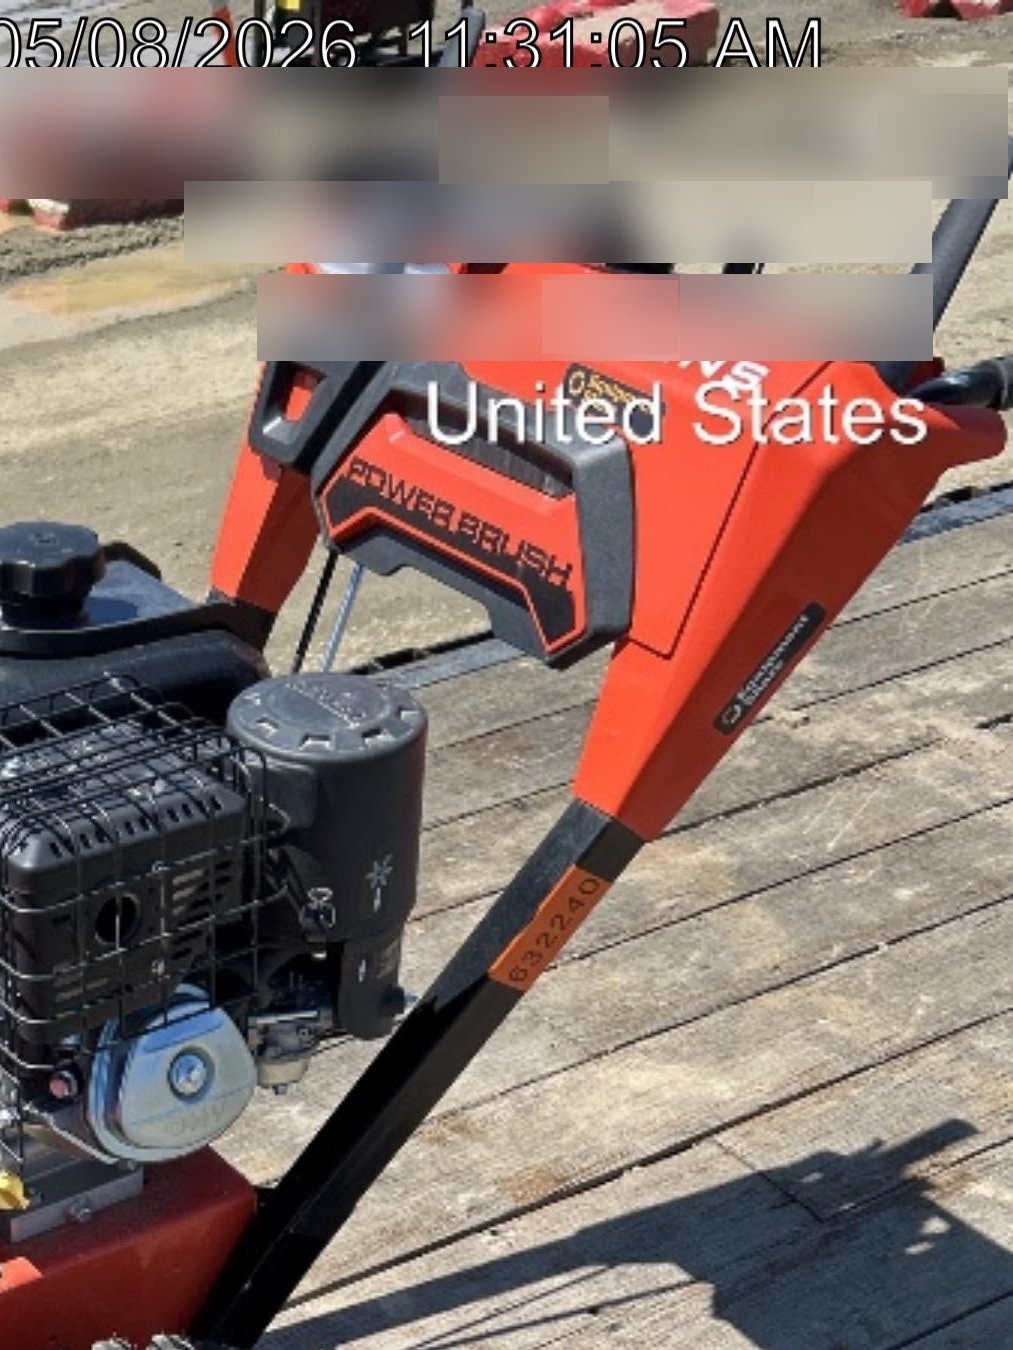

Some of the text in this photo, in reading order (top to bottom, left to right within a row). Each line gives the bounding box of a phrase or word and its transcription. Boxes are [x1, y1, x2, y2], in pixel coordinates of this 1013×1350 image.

[348, 456, 573, 587] POWER BRUSH
[508, 878, 601, 981] 632240
